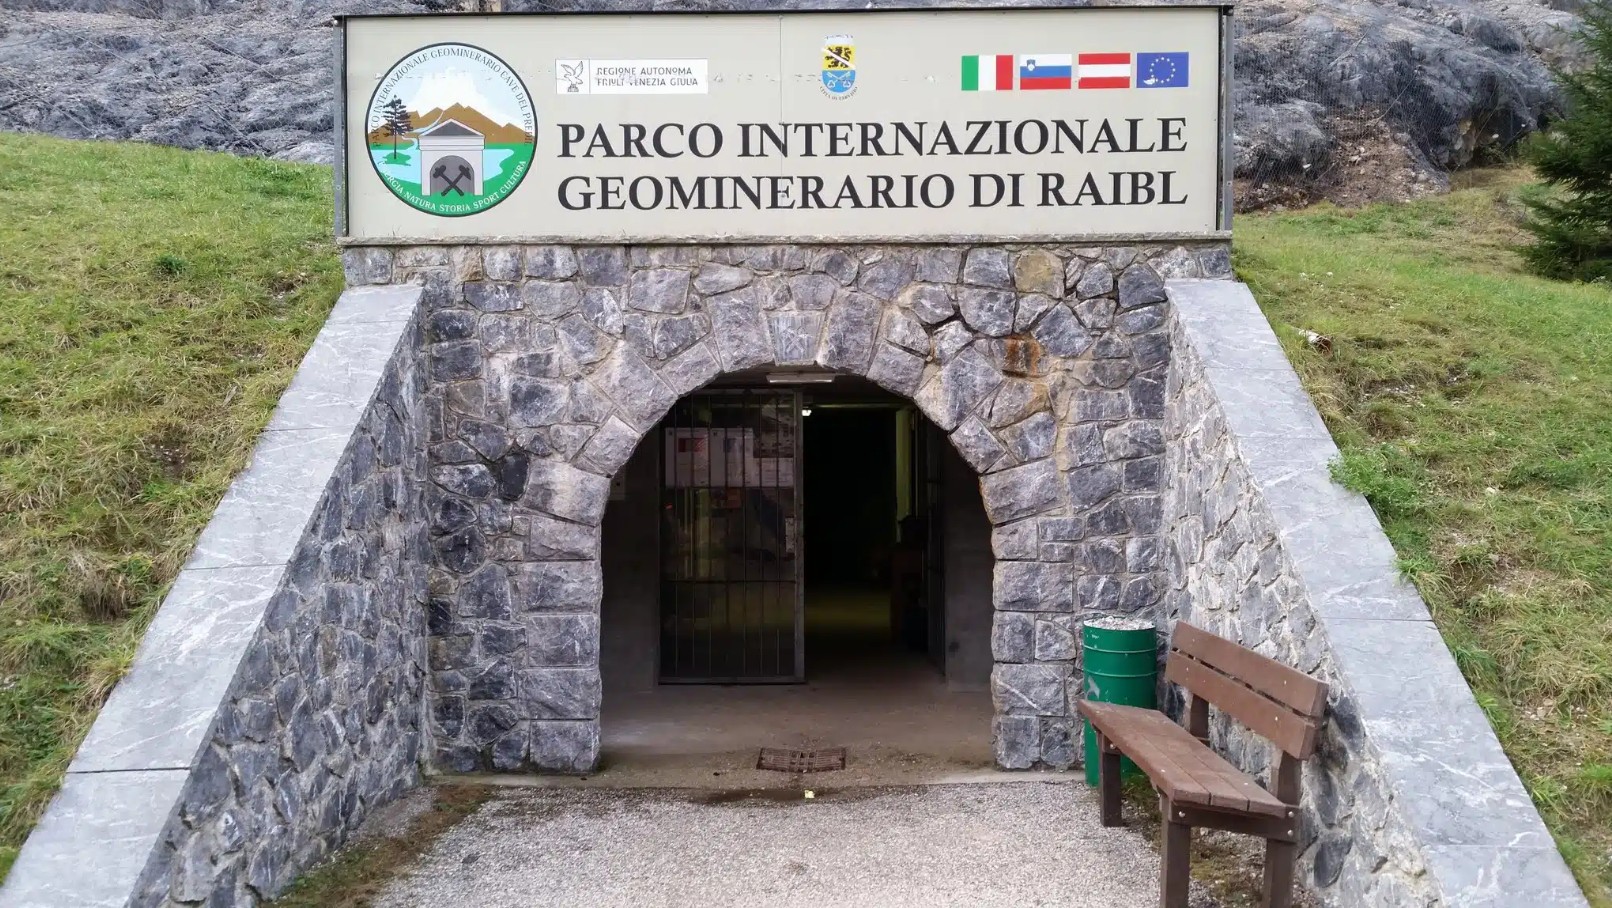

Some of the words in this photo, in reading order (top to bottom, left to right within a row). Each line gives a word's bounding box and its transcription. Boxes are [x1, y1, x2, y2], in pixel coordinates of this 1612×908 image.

[431, 47, 502, 73] GEOMINERARIO
[597, 66, 636, 76] REGIONE
[640, 66, 692, 76] AUTONOMA
[374, 53, 430, 114] INTERNAZIONALE
[500, 71, 519, 93] CAVE
[628, 77, 666, 87] VENEZIA
[670, 77, 698, 87] GIULIA
[515, 92, 528, 111] DEL
[371, 116, 382, 147] PARCO
[557, 123, 723, 158] PARCO
[737, 117, 1188, 158] INTERNAZIONALE
[404, 191, 436, 210] NATURA
[440, 203, 471, 213] STORIA
[473, 192, 500, 209] SPORT
[499, 160, 527, 194] CULTURA
[557, 173, 955, 211] GEOMINERARIO
[968, 173, 1025, 208] DI
[1036, 170, 1188, 207] RAIBL
